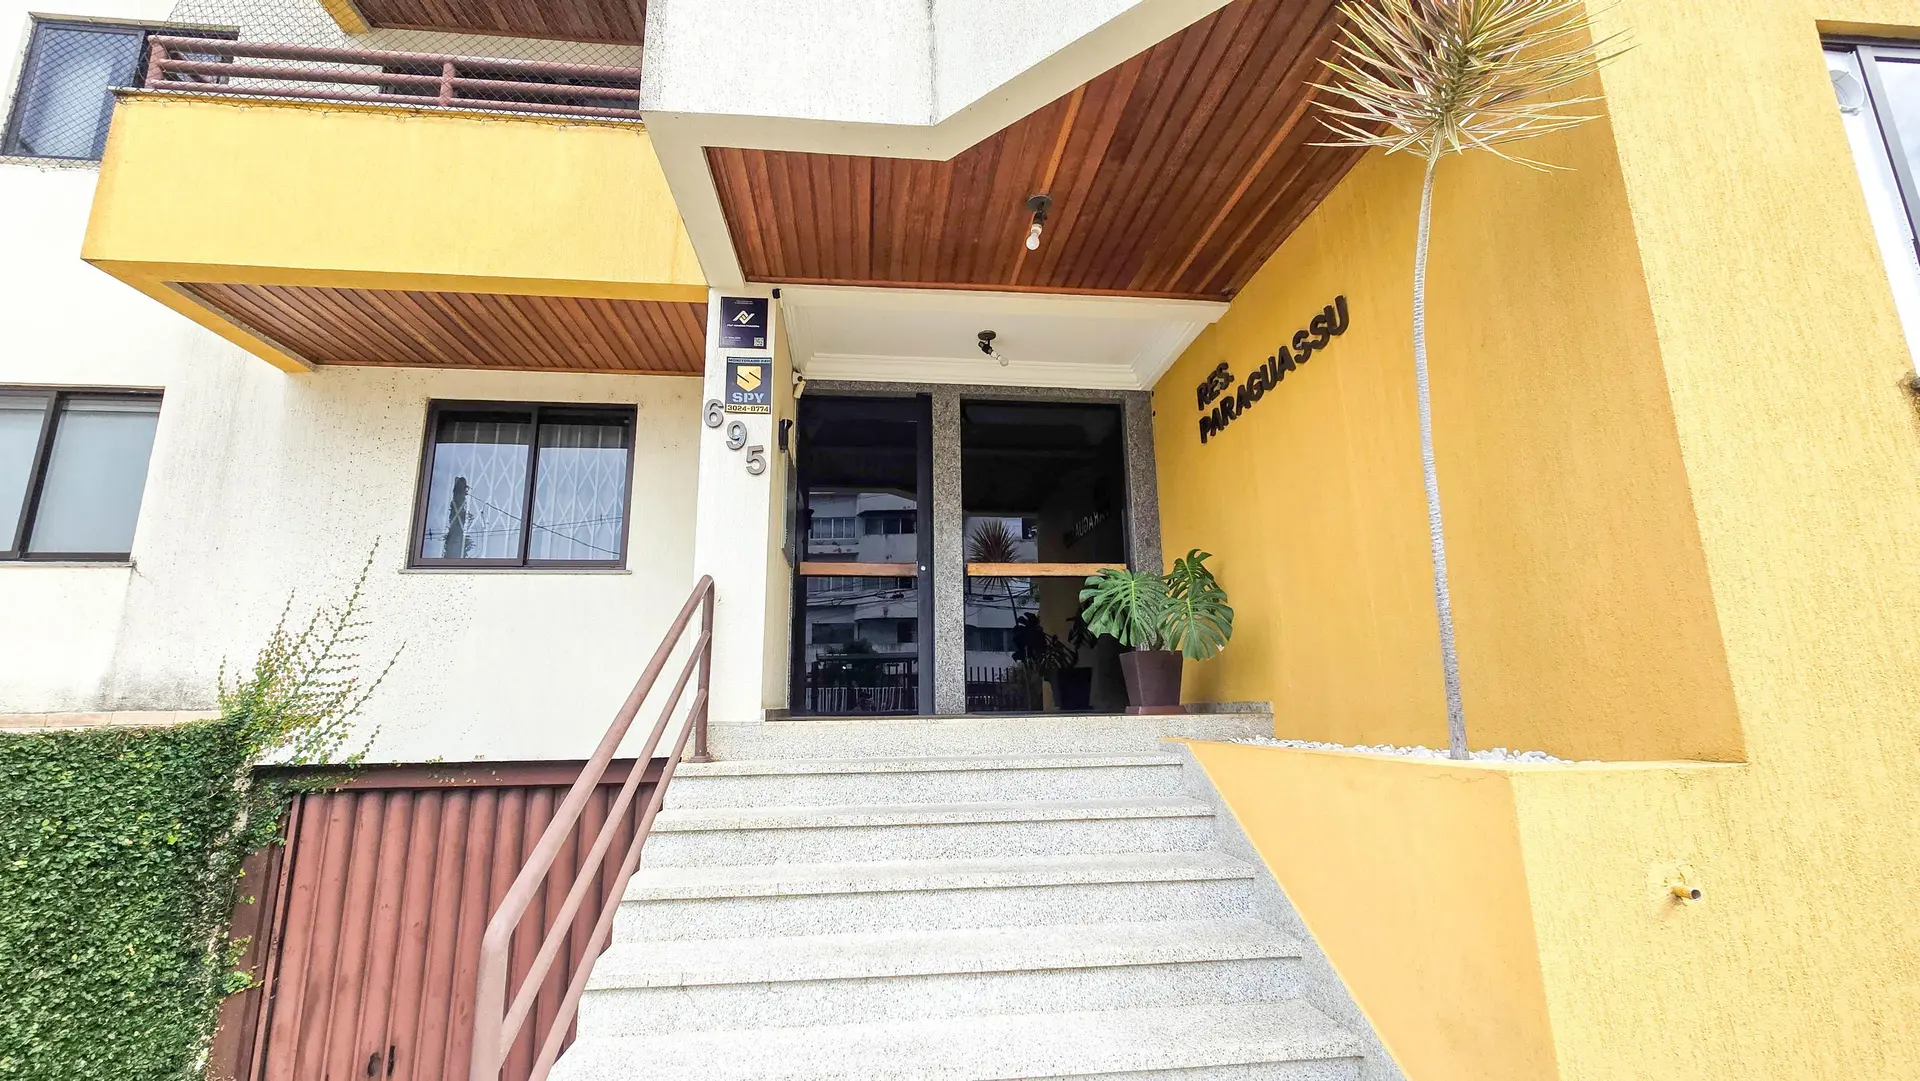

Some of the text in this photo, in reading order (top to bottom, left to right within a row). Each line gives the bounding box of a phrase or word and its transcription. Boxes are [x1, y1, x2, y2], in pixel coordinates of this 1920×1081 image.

[1199, 295, 1350, 444] PARAGUASSU
[732, 392, 765, 403] SPY
[1197, 362, 1235, 411] RES.
[727, 404, 769, 412] 3024-8774
